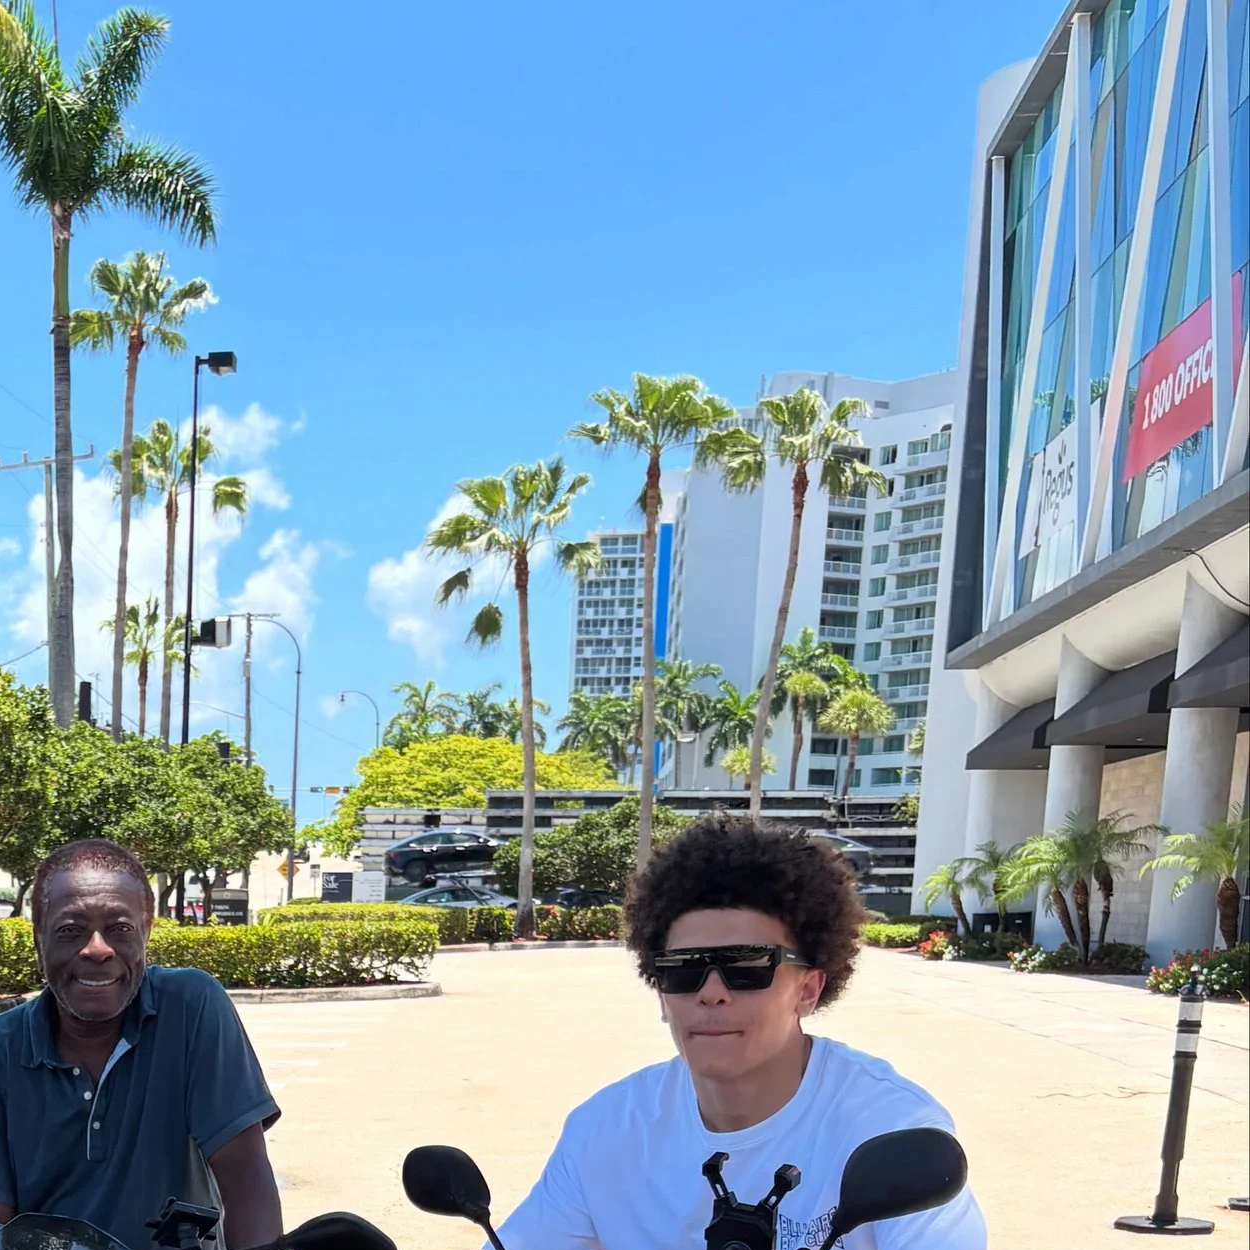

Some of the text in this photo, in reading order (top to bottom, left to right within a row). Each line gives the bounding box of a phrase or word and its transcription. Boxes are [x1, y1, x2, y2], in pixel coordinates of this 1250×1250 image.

[1142, 338, 1214, 430] 1 800 OFFIC
[1043, 461, 1075, 525] Regus
